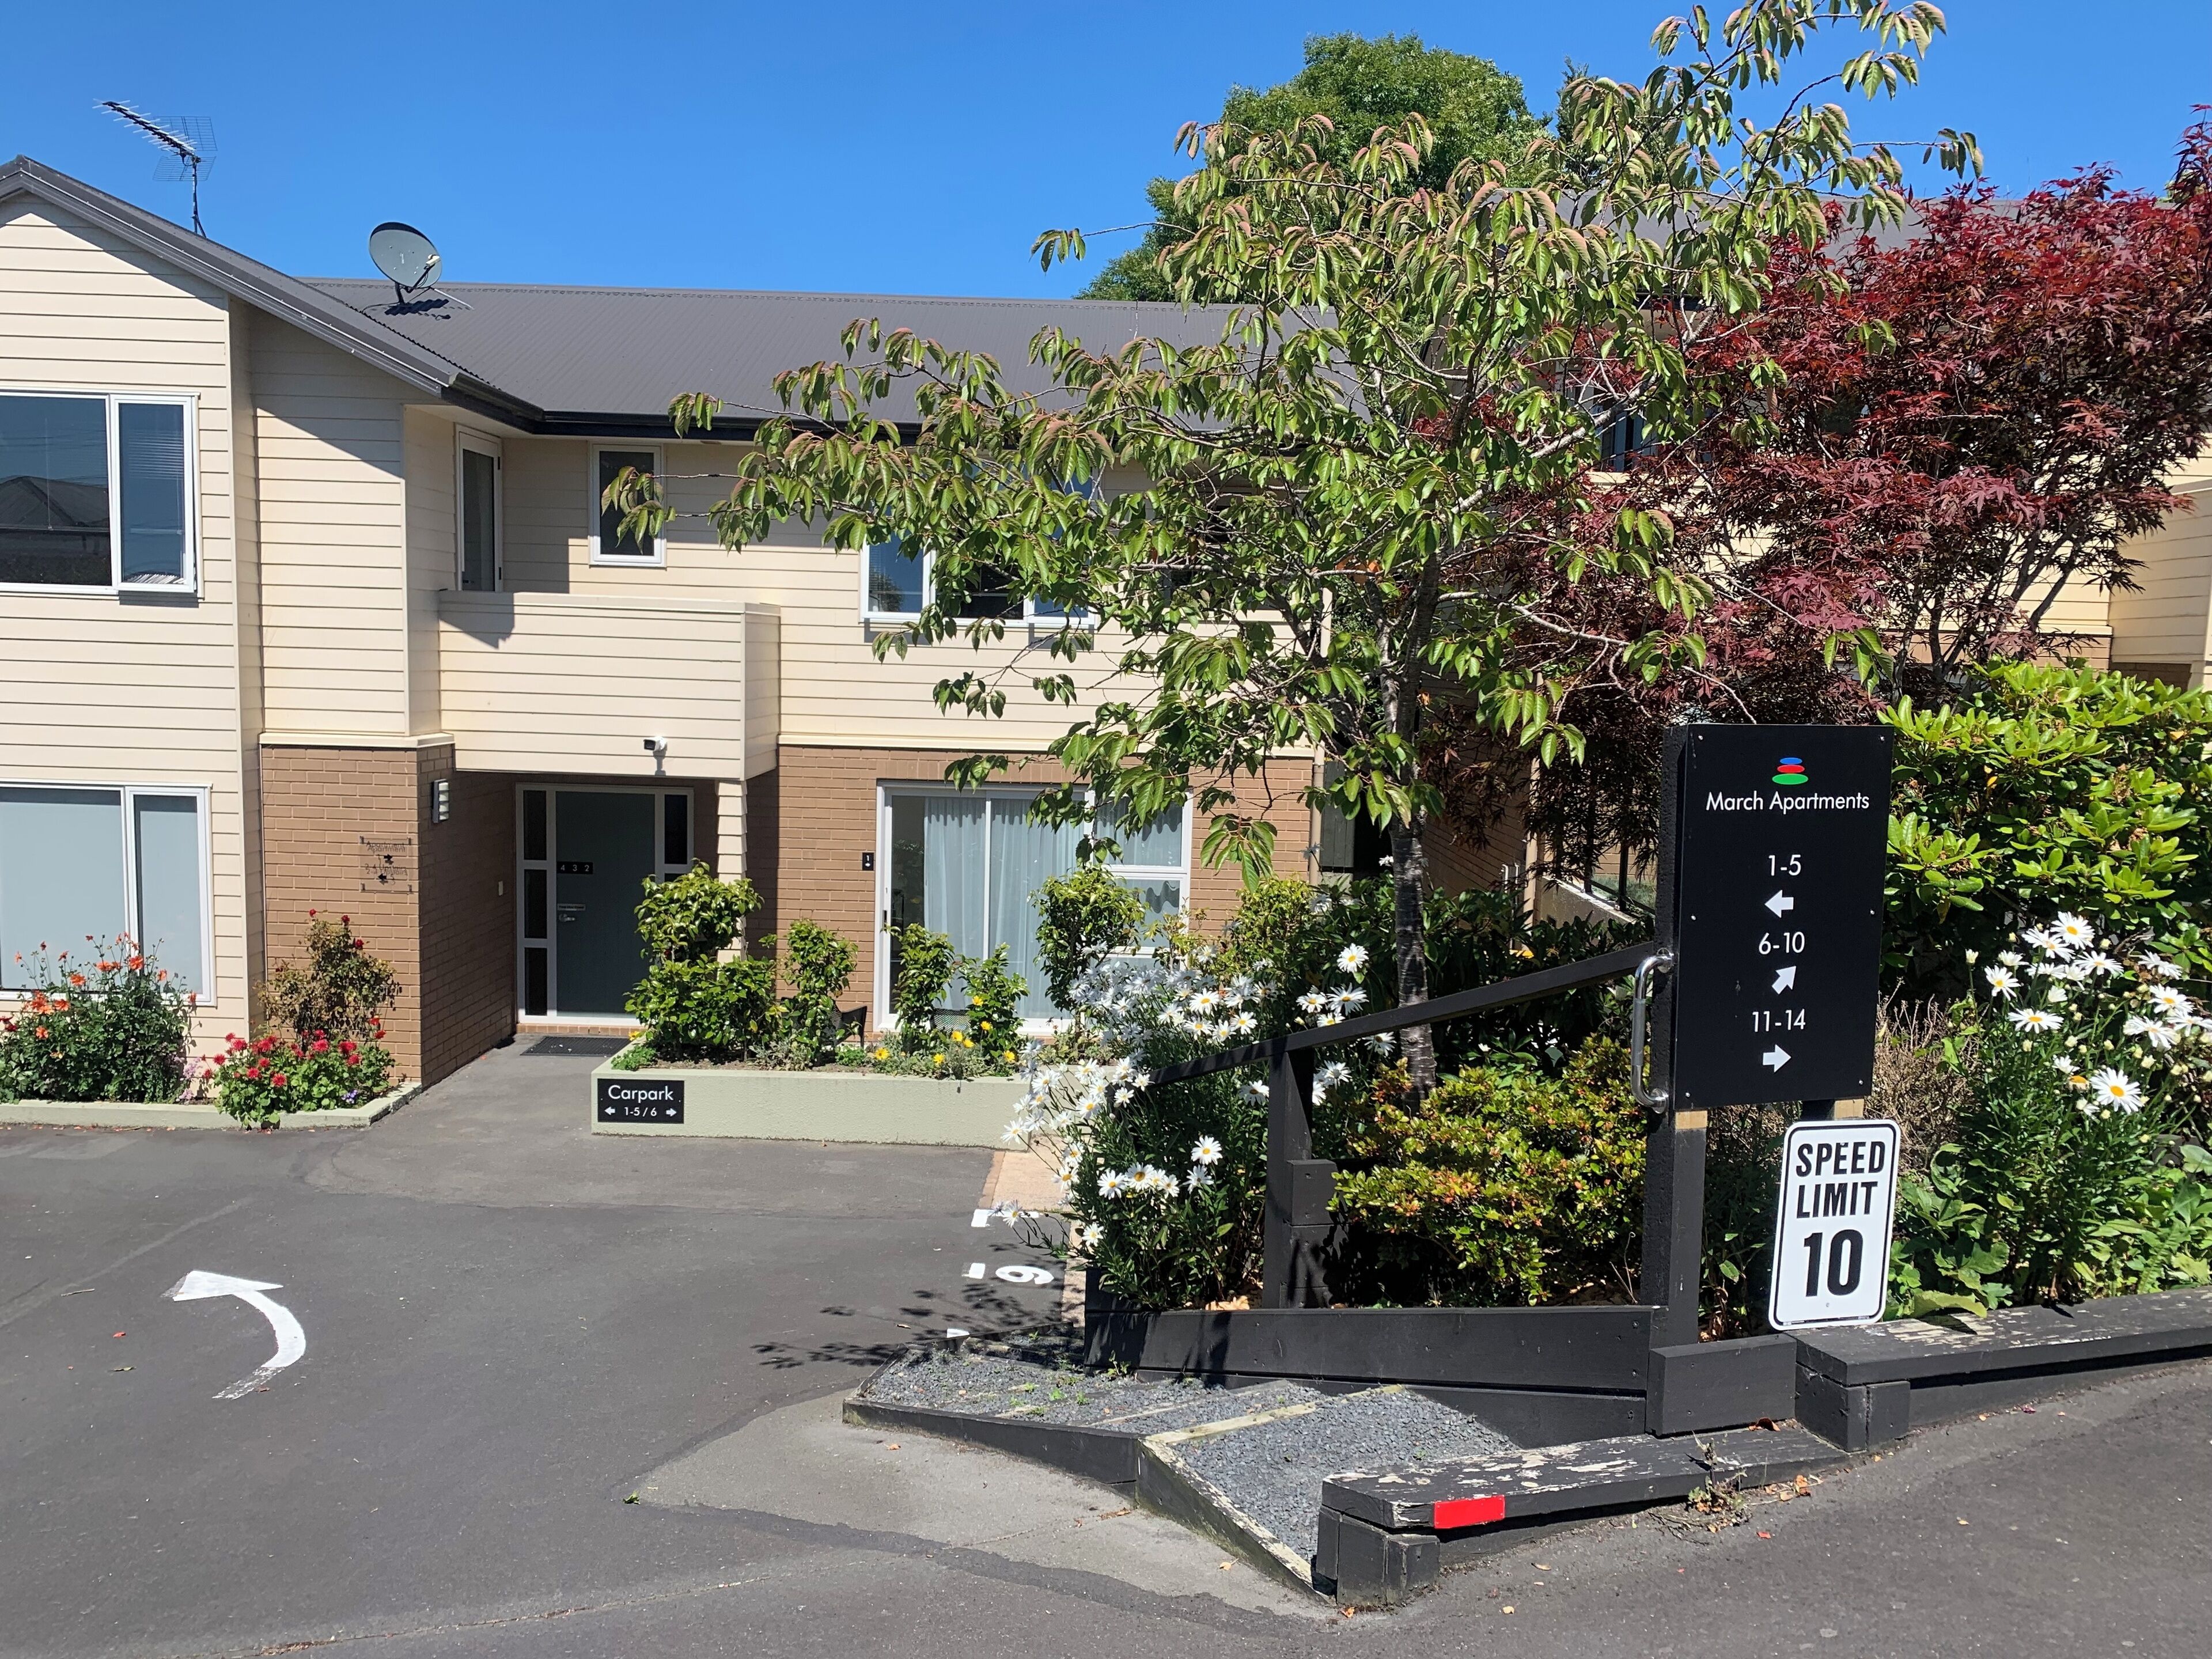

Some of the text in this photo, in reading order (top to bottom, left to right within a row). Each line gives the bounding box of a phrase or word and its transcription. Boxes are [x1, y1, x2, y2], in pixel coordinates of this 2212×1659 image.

[1706, 791, 1869, 815] March Apartments
[366, 841, 406, 851] Apartment
[1768, 854, 1801, 876] 1-5
[1759, 931, 1805, 955] 6-10
[1752, 1008, 1806, 1032] 11-14
[608, 1085, 674, 1104] Carpark
[1796, 1141, 1885, 1177] SPEED
[1796, 1181, 1878, 1219] LIMIT
[1804, 1229, 1863, 1297] 10
